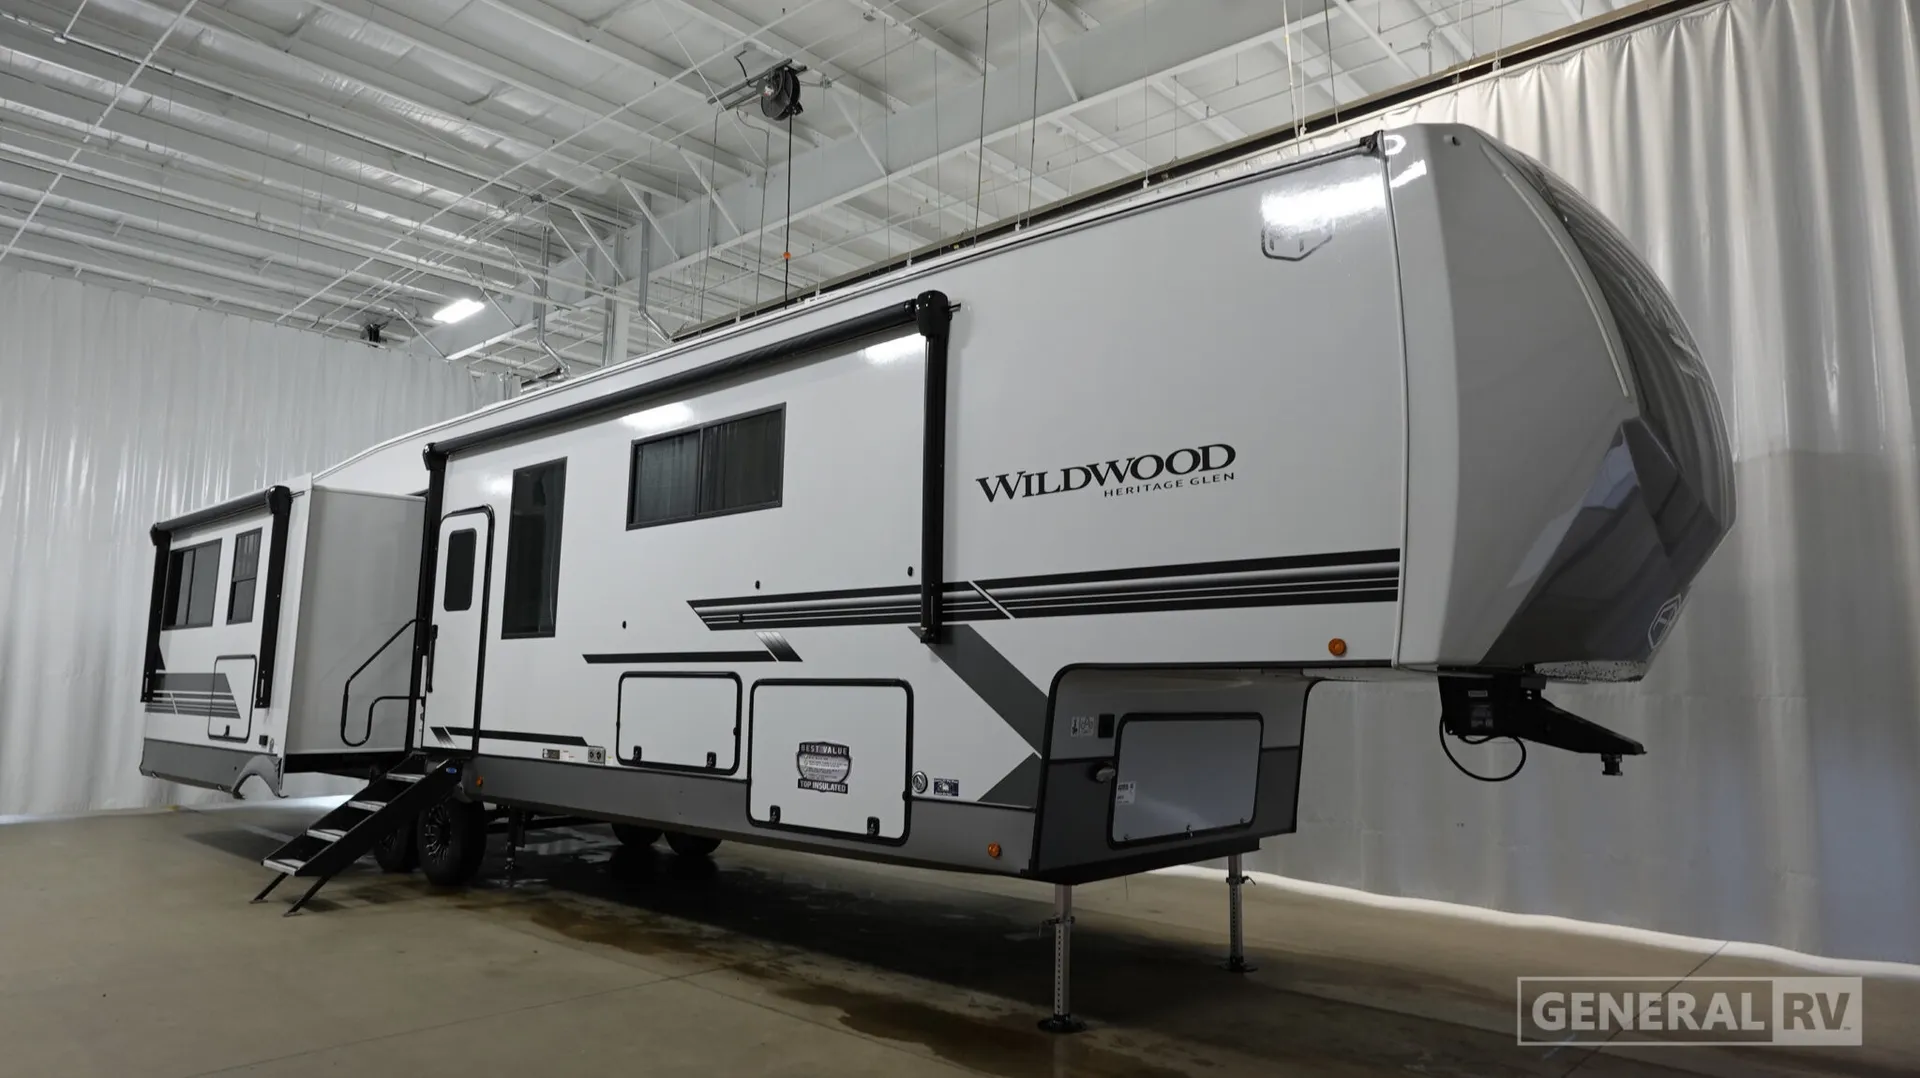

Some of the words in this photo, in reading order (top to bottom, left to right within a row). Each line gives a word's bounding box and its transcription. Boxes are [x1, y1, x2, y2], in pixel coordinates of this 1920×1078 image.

[1103, 478, 1184, 498] HERITAGE
[1189, 472, 1235, 486] GLEN
[801, 744, 819, 753] BEST
[823, 746, 847, 755] VALUE
[800, 781, 811, 789] TOP
[812, 781, 846, 792] INSULATED
